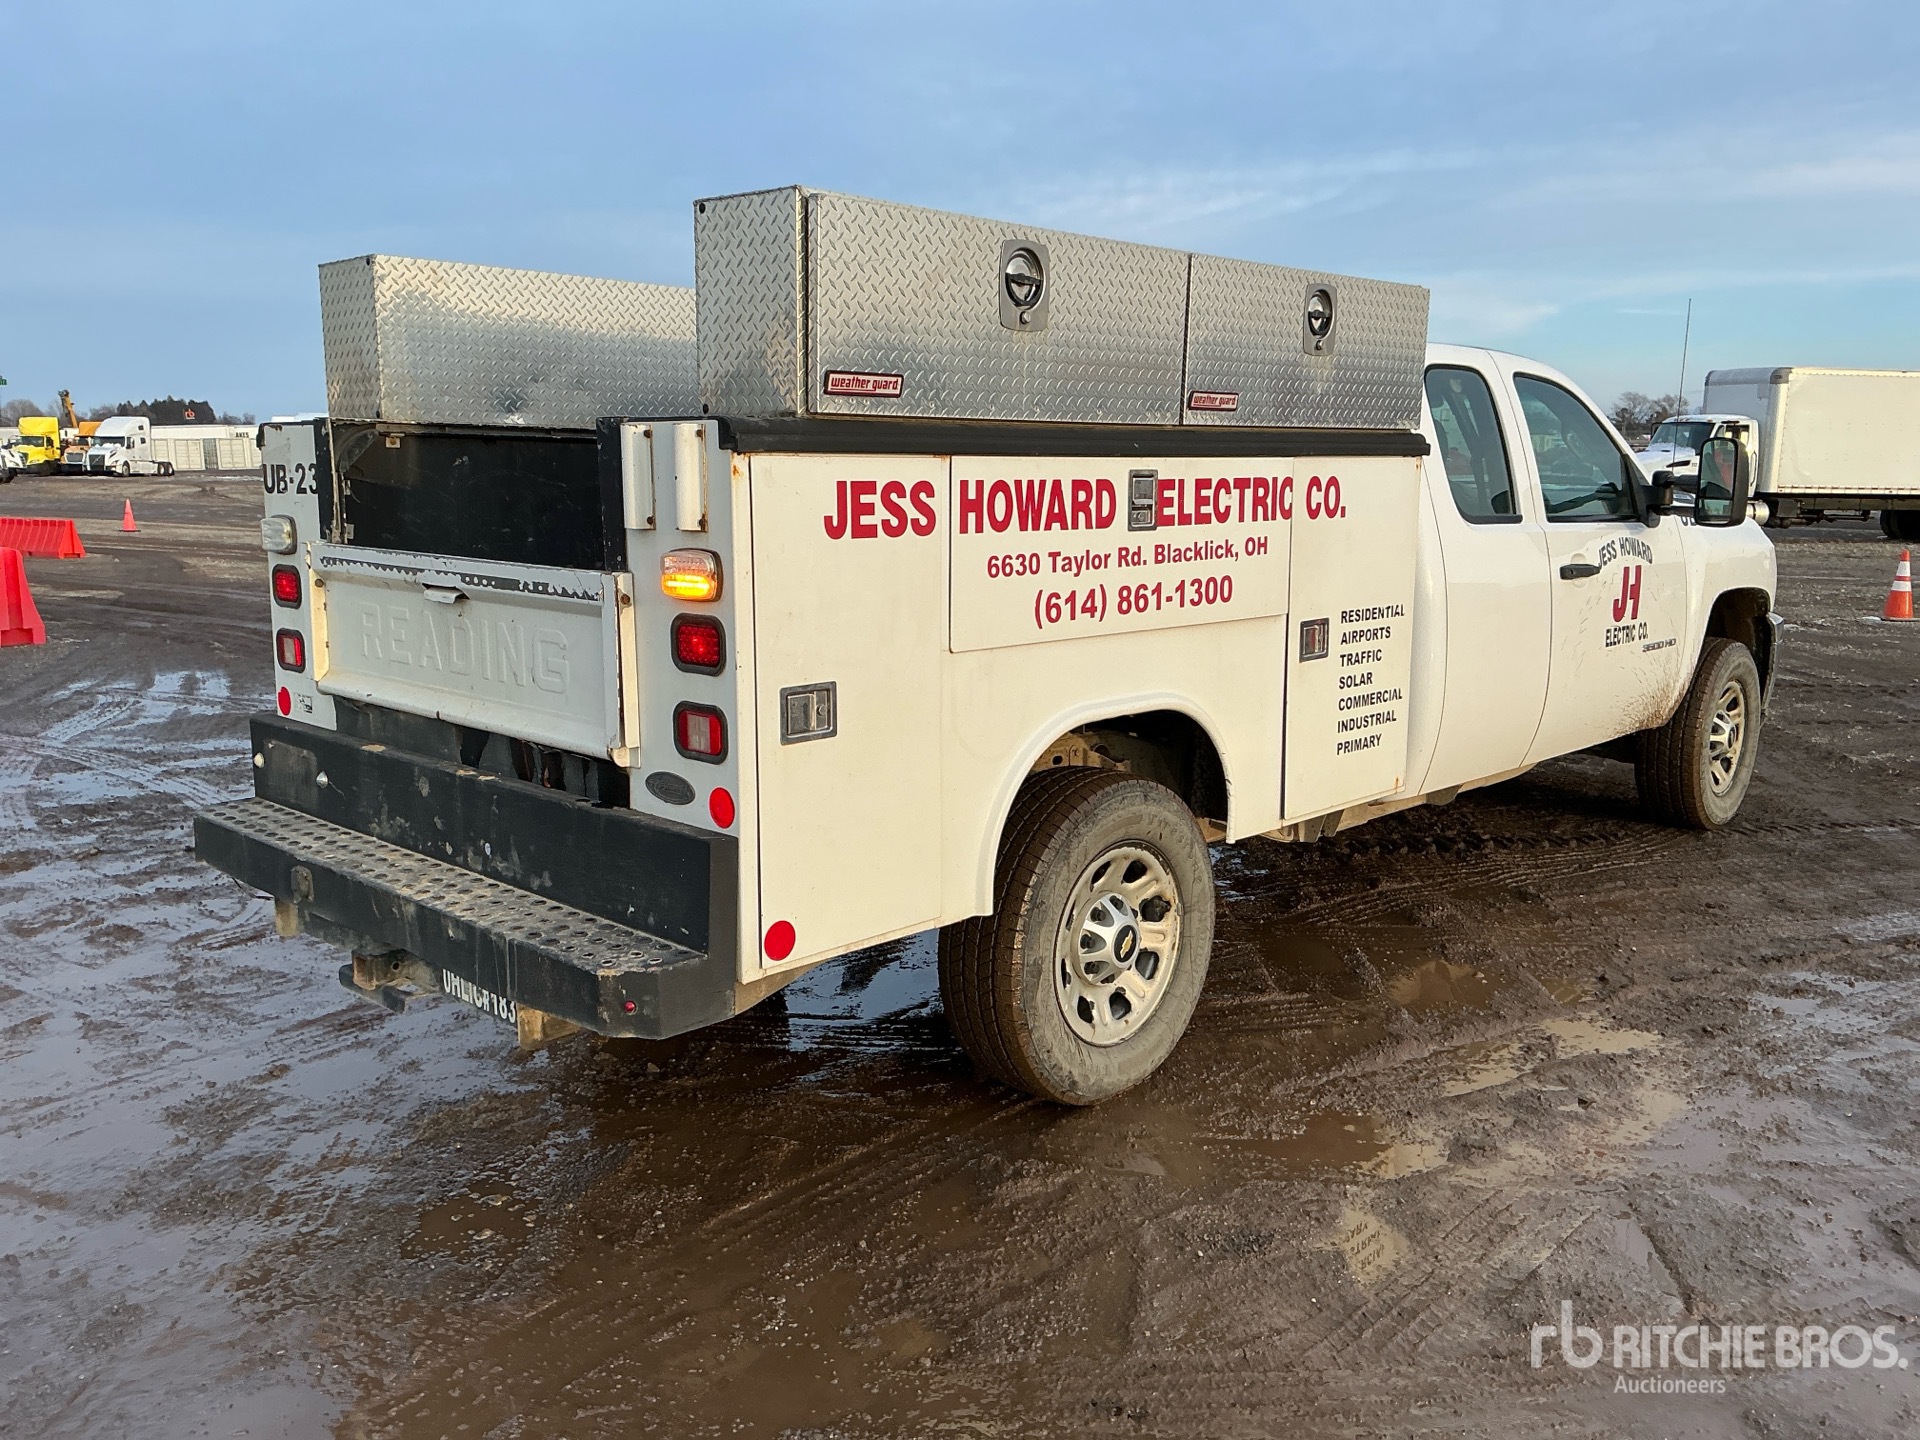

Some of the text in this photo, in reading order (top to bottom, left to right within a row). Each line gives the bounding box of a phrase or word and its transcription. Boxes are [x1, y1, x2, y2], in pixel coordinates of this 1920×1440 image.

[830, 375, 899, 391] weather guard
[1194, 395, 1235, 406] weather guard
[823, 475, 1347, 540] JESS HOWARD ELECTRIC CO.
[987, 535, 1269, 579] 6630 Taylor Rd. Blacklick, OH
[1598, 537, 1652, 570] JESS HOWARD
[1034, 574, 1234, 630] (614) 861-1300
[1340, 603, 1405, 624] RESIDENTIAL
[1340, 625, 1392, 646] AIRPORTS
[1605, 621, 1649, 648] ELECTRIC CO.
[359, 603, 571, 693] READING
[1339, 648, 1383, 668] TRAFFIC
[1338, 671, 1374, 690] SOLAR
[1338, 687, 1403, 711] COMMERCIAL
[1337, 709, 1397, 734] INDUSTRIAL
[1336, 732, 1383, 756] PRIMARY
